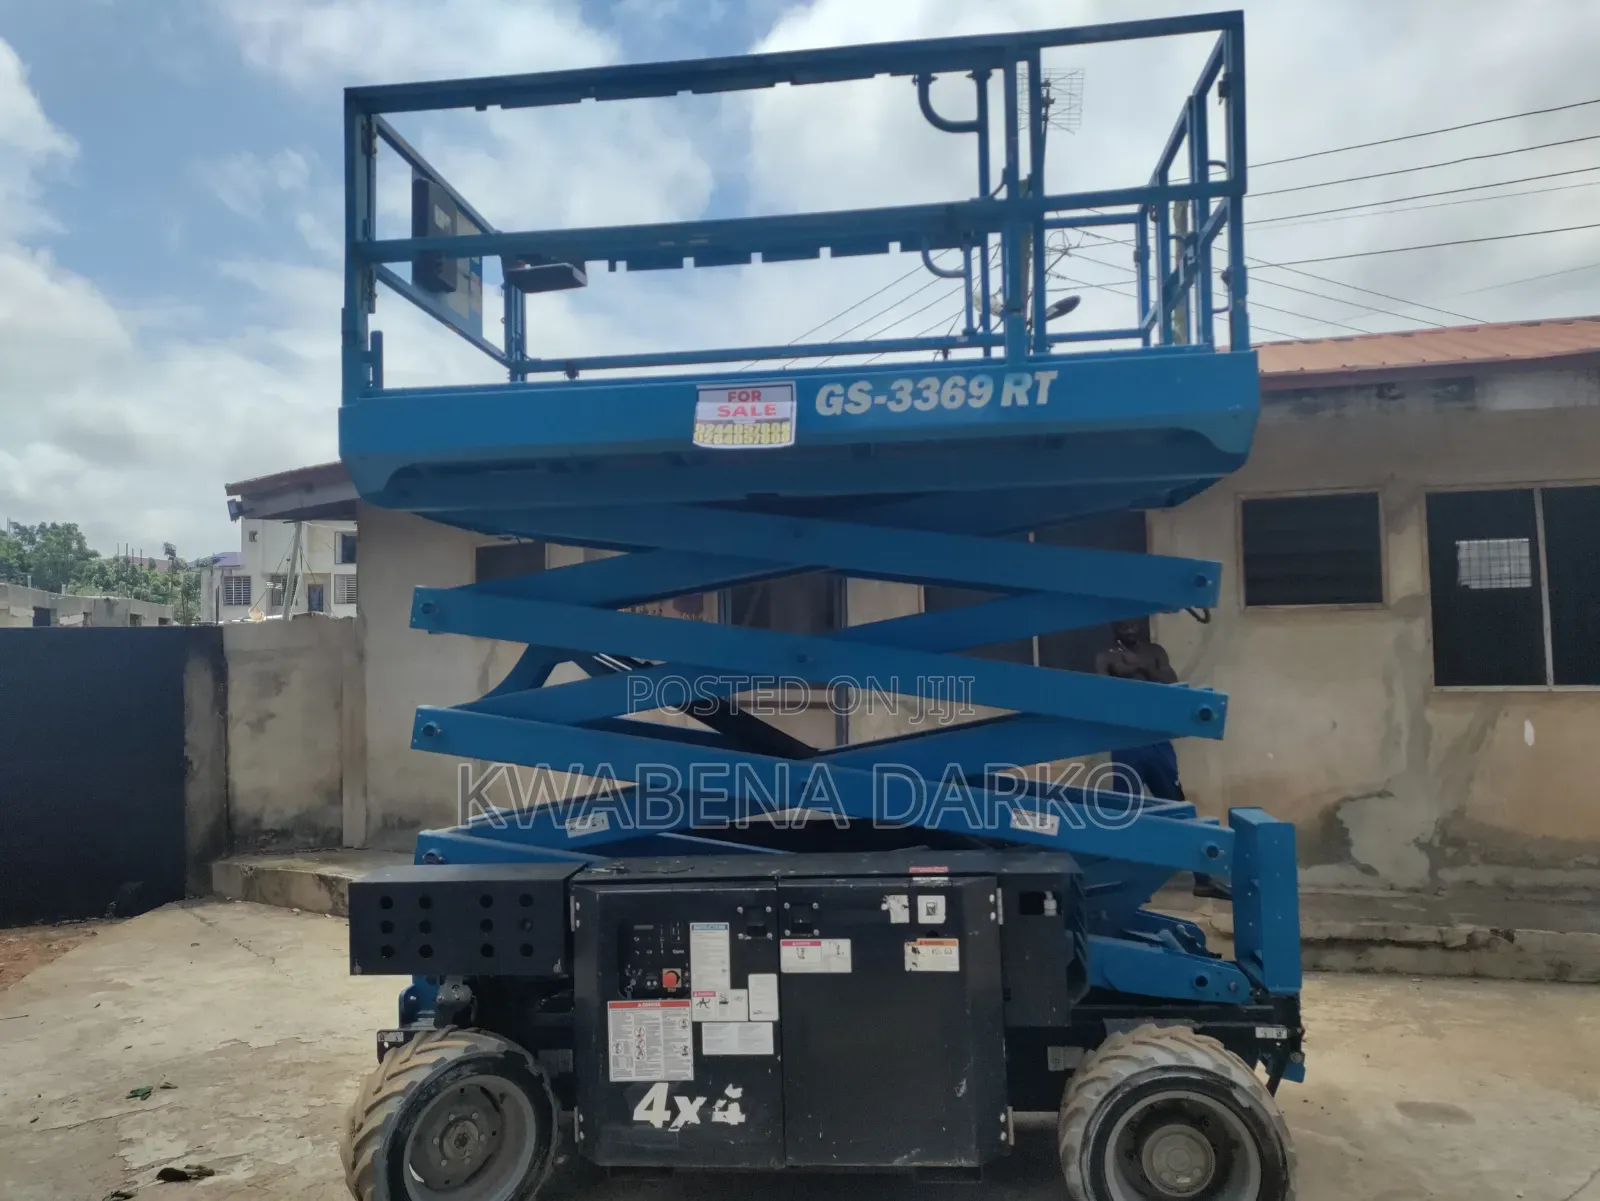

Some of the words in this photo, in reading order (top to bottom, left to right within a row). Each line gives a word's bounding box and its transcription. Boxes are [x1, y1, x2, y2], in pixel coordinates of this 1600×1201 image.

[728, 390, 762, 402] FOR
[815, 374, 994, 416] GS-3369
[1000, 370, 1059, 407] RT
[718, 403, 777, 417] SALE
